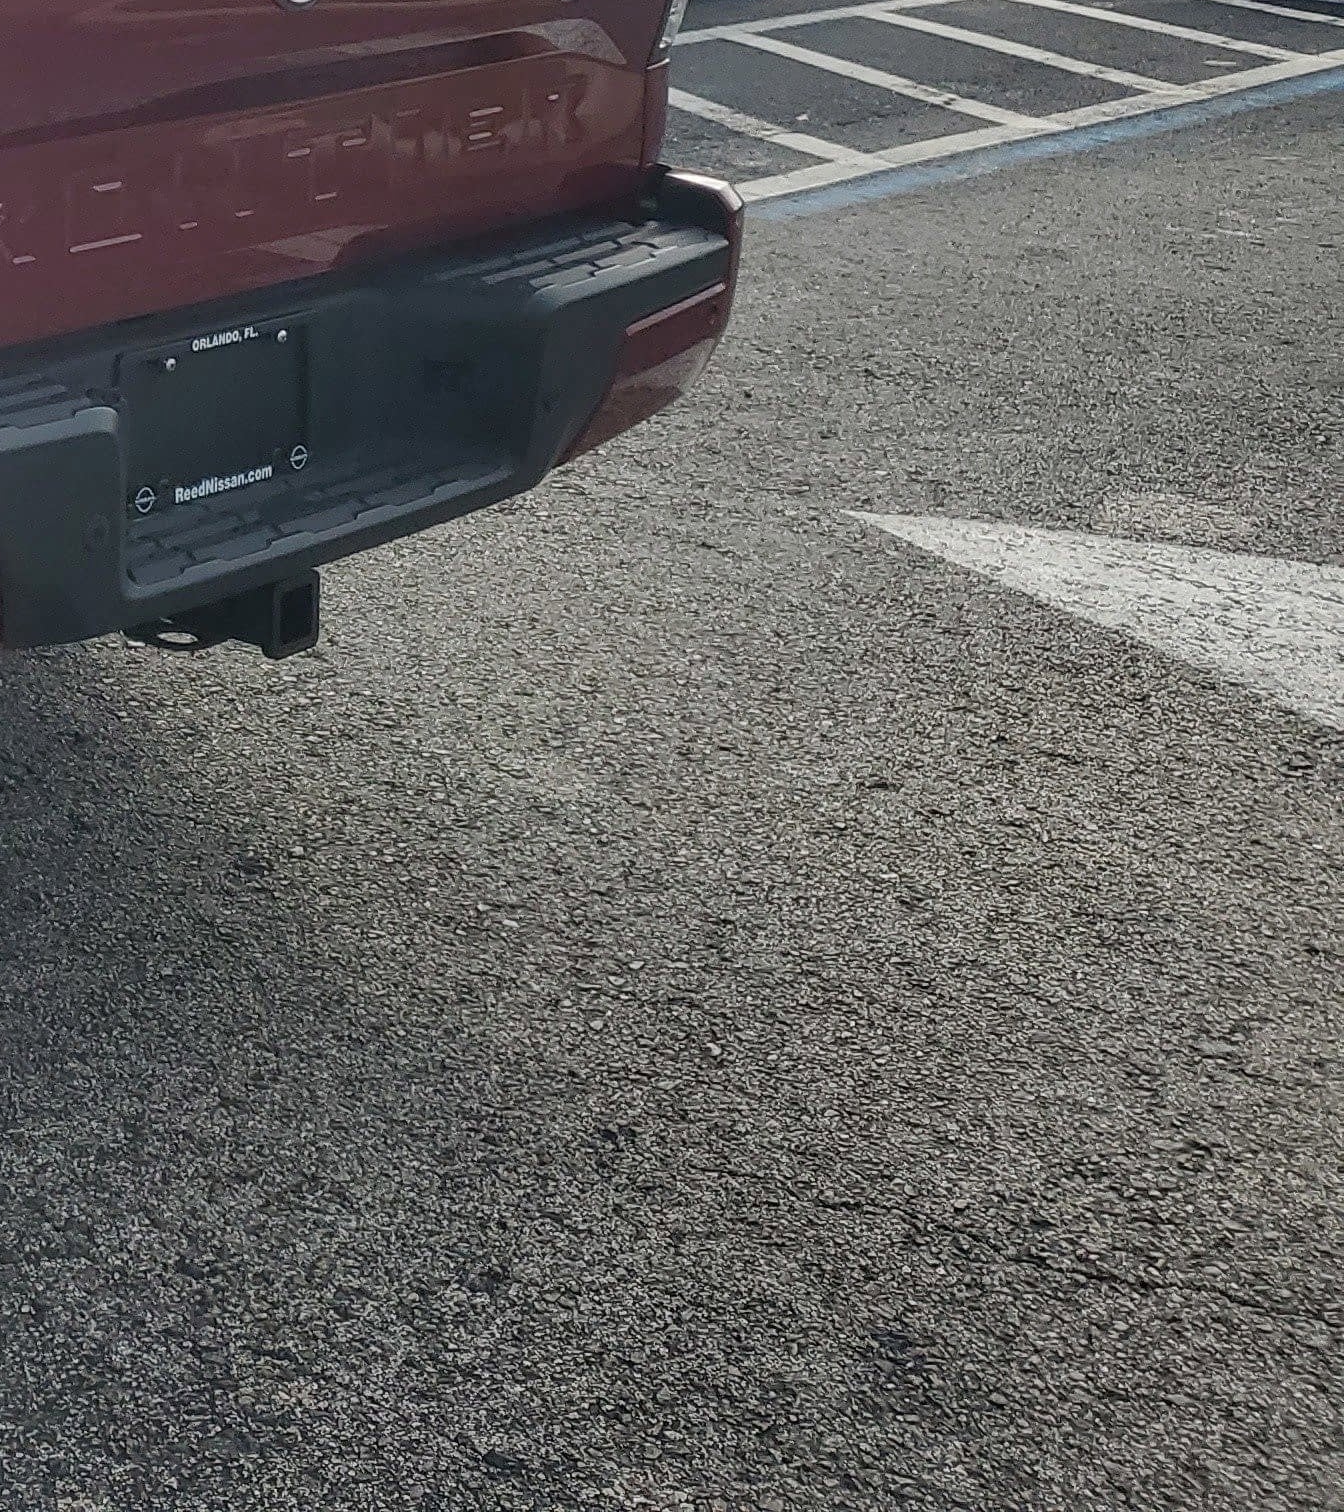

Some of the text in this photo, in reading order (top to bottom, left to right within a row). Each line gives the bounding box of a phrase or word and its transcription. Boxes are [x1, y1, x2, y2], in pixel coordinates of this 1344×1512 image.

[191, 325, 260, 353] ORLANDO, FL.
[174, 464, 273, 505] ReedNissan.com
